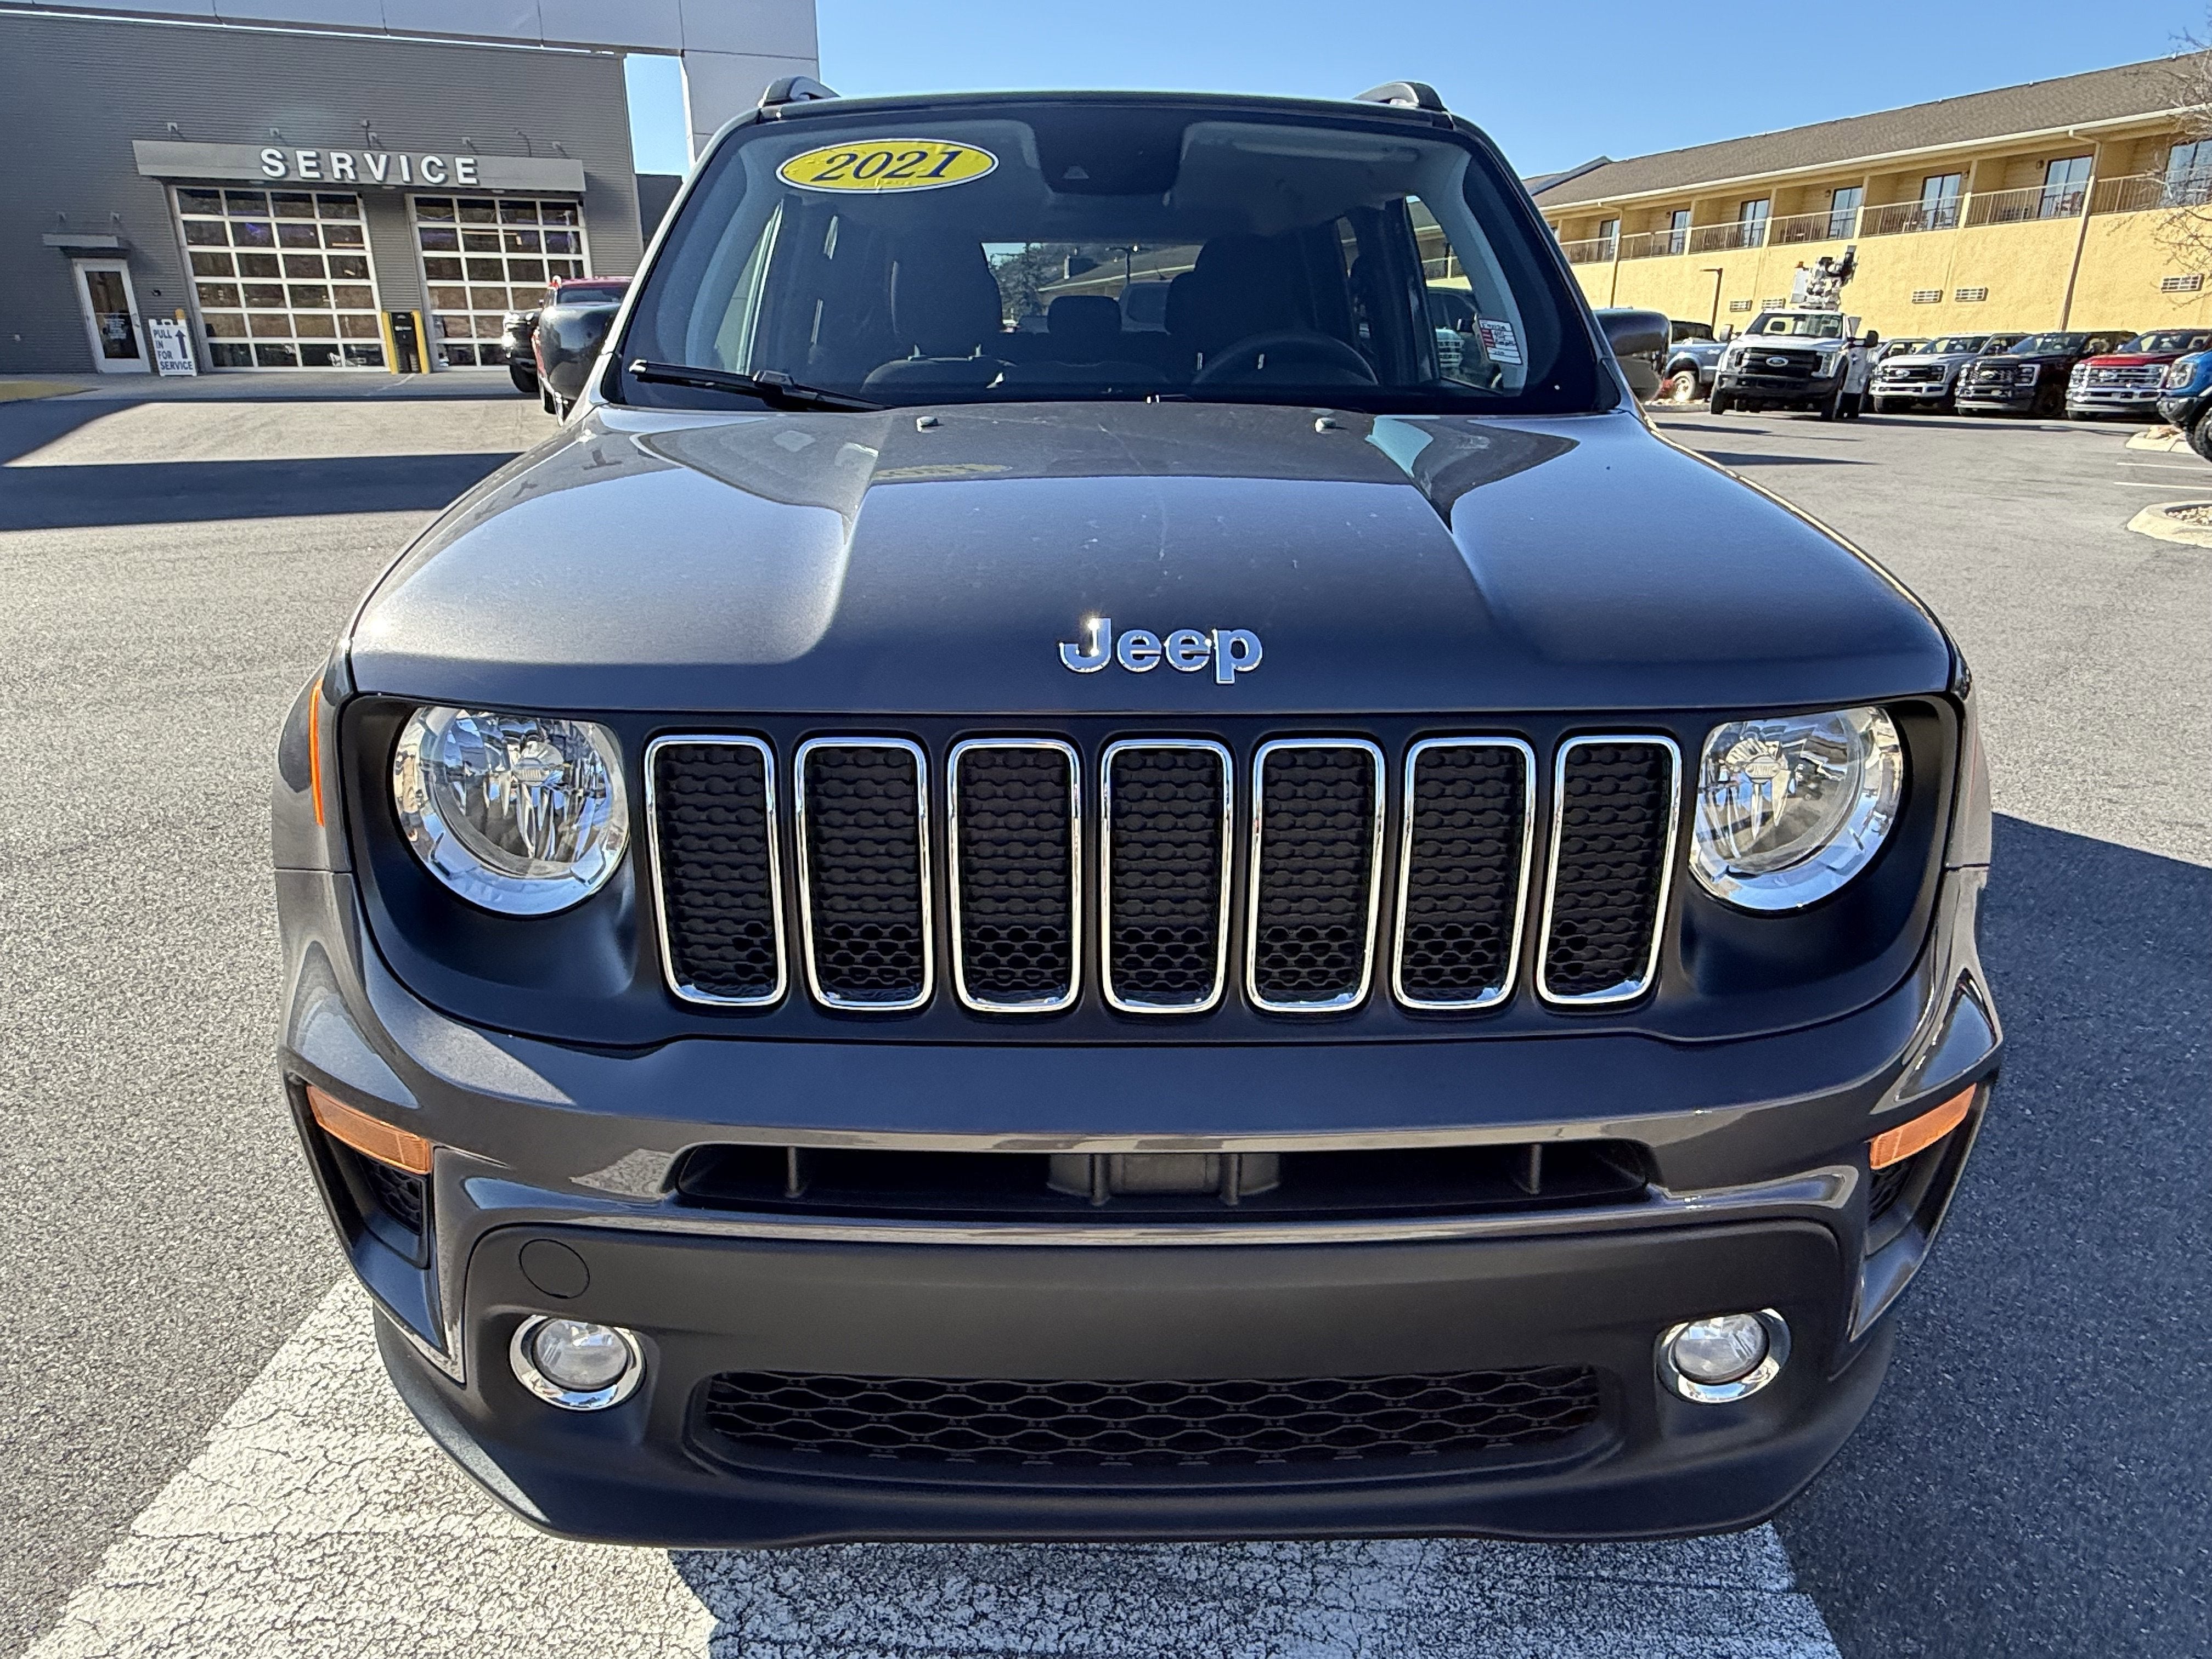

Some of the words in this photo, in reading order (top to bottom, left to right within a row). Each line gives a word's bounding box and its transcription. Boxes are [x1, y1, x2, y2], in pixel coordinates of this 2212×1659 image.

[260, 148, 479, 184] SERVICE
[810, 150, 963, 182] 2021
[153, 329, 173, 338] PULL
[156, 340, 164, 349] IN
[157, 350, 173, 359] FOR
[160, 361, 193, 370] SERVICE
[1059, 618, 1263, 684] Jeep
